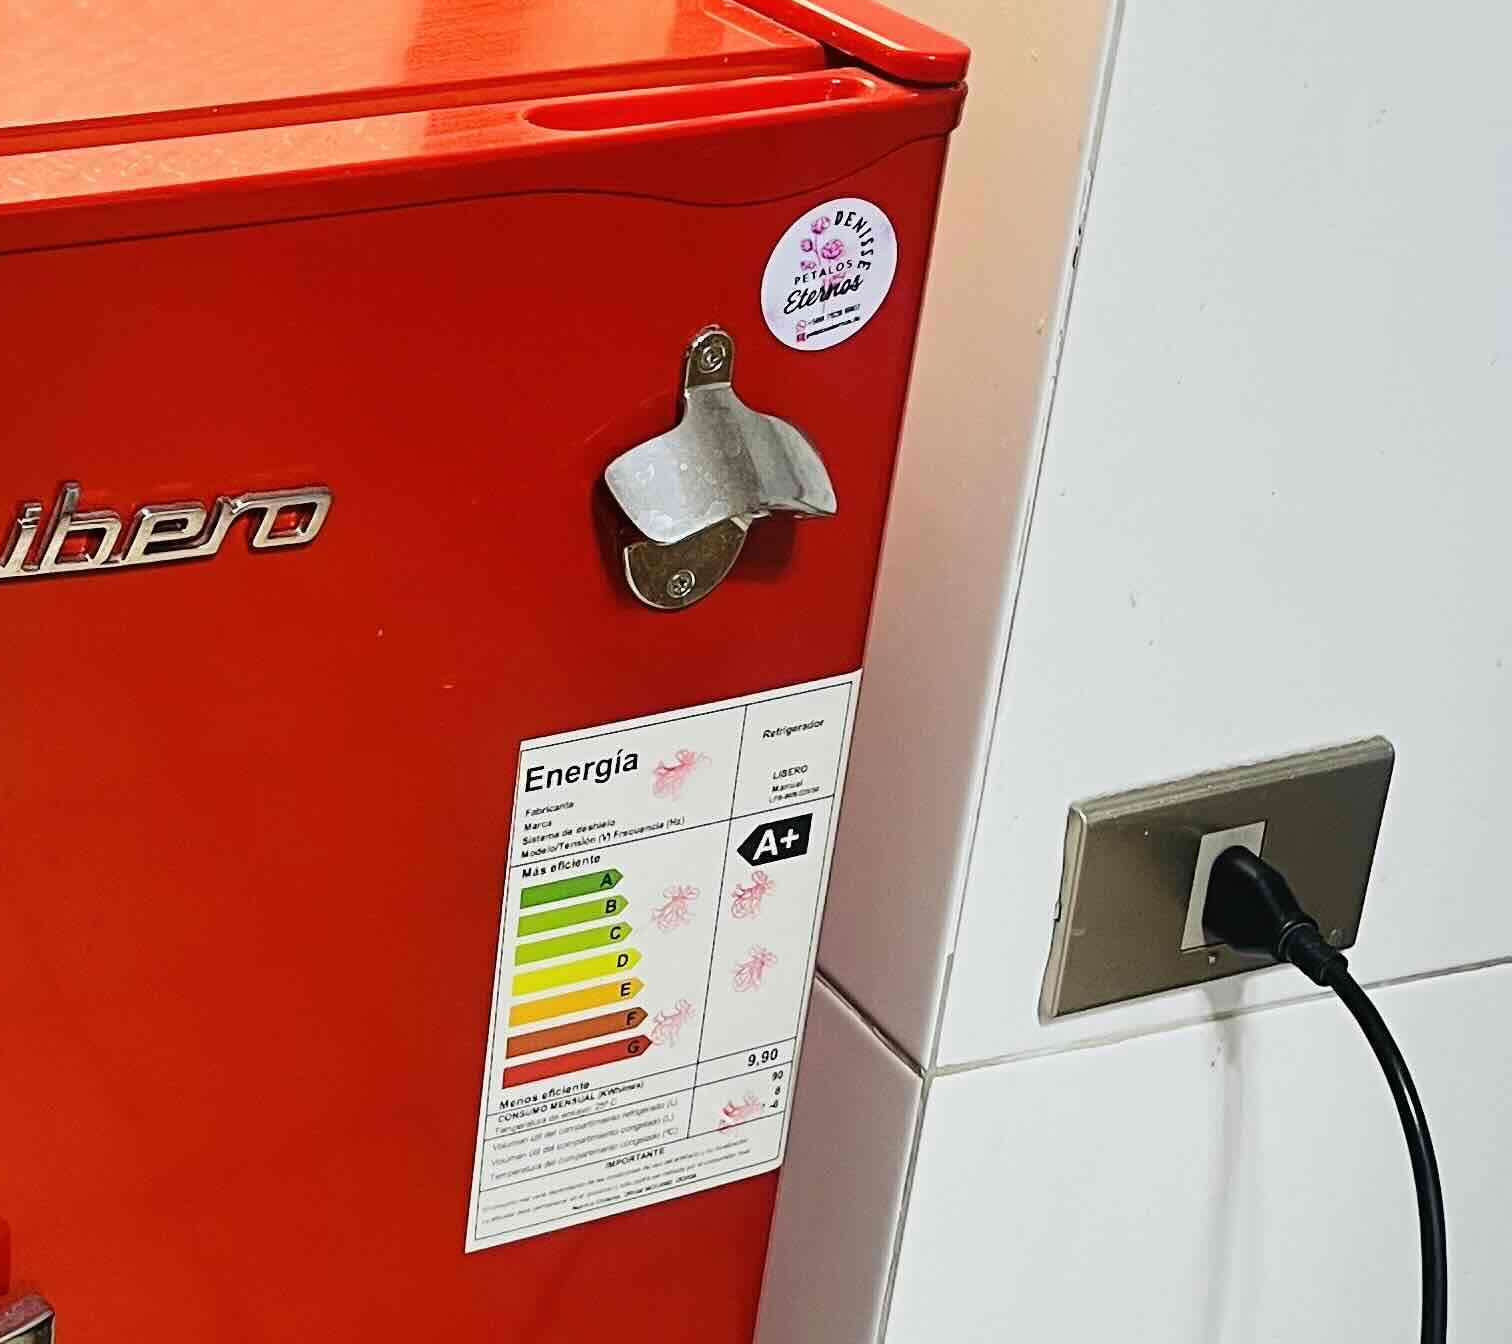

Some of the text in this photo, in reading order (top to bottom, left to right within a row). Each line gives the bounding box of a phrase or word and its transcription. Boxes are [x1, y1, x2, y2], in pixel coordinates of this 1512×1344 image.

[834, 210, 875, 270] DENISSE
[794, 259, 853, 285] PETALOS
[783, 274, 864, 315] Eternos
[763, 719, 824, 739] Refrigerador
[525, 749, 639, 792] Energía
[525, 800, 575, 817] Fabricante
[522, 819, 616, 846] Sistema de deshielo
[524, 820, 552, 832] Marca
[613, 821, 665, 840] Frecuencia
[752, 828, 800, 861] A+
[550, 855, 601, 874] eficiente
[600, 872, 613, 888] A
[605, 899, 617, 914] B
[609, 926, 621, 940] C
[617, 953, 629, 968] D
[620, 982, 631, 997] E
[626, 1011, 637, 1026] F
[627, 1040, 639, 1054] G
[499, 1082, 589, 1110] Menos eficiente
[498, 1107, 547, 1123] CONSUMO
[605, 1149, 664, 1168] IMPORTANTE
